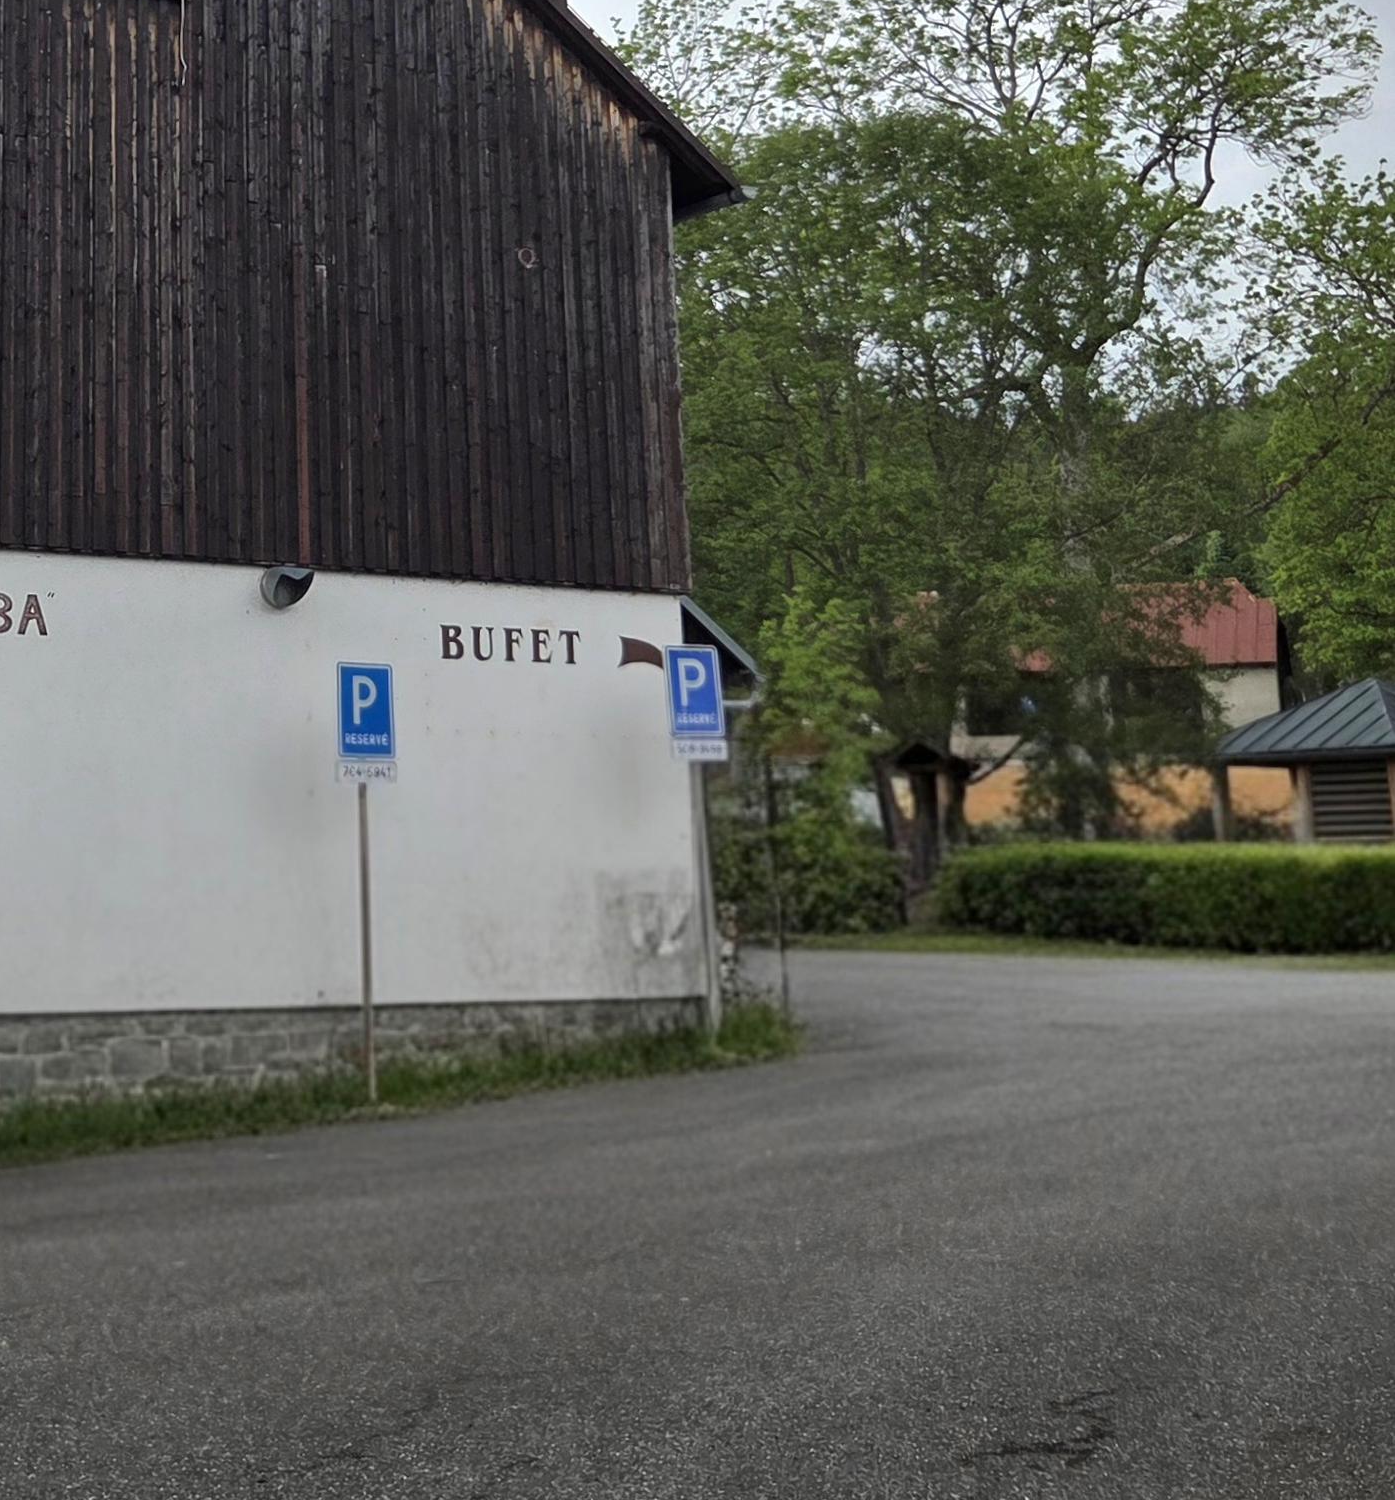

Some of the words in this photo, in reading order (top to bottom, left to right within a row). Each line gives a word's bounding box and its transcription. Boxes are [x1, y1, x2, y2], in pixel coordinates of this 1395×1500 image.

[440, 624, 581, 665] BUFET
[352, 675, 377, 725] P
[677, 657, 706, 707] P
